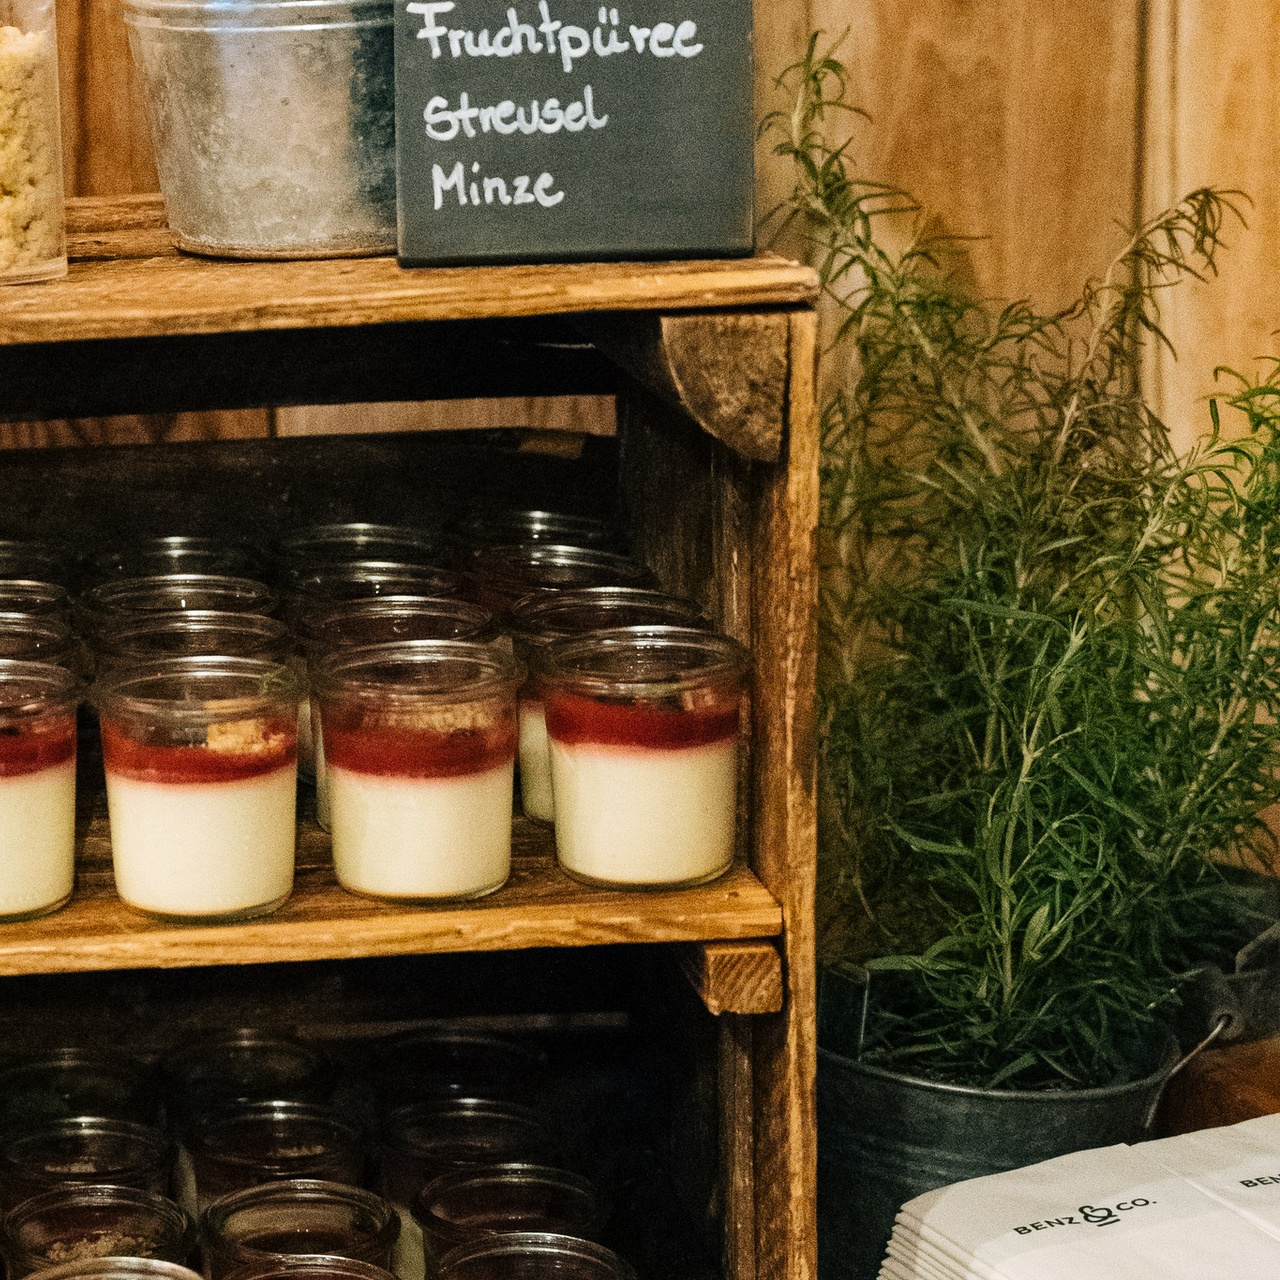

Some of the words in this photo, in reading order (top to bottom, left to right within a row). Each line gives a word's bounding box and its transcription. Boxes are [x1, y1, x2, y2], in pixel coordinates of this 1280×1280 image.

[405, 0, 704, 73] Fruchtpüree
[431, 161, 565, 211] Minze
[1013, 1216, 1081, 1235] BENZ
[1116, 1198, 1157, 1211] CO.
